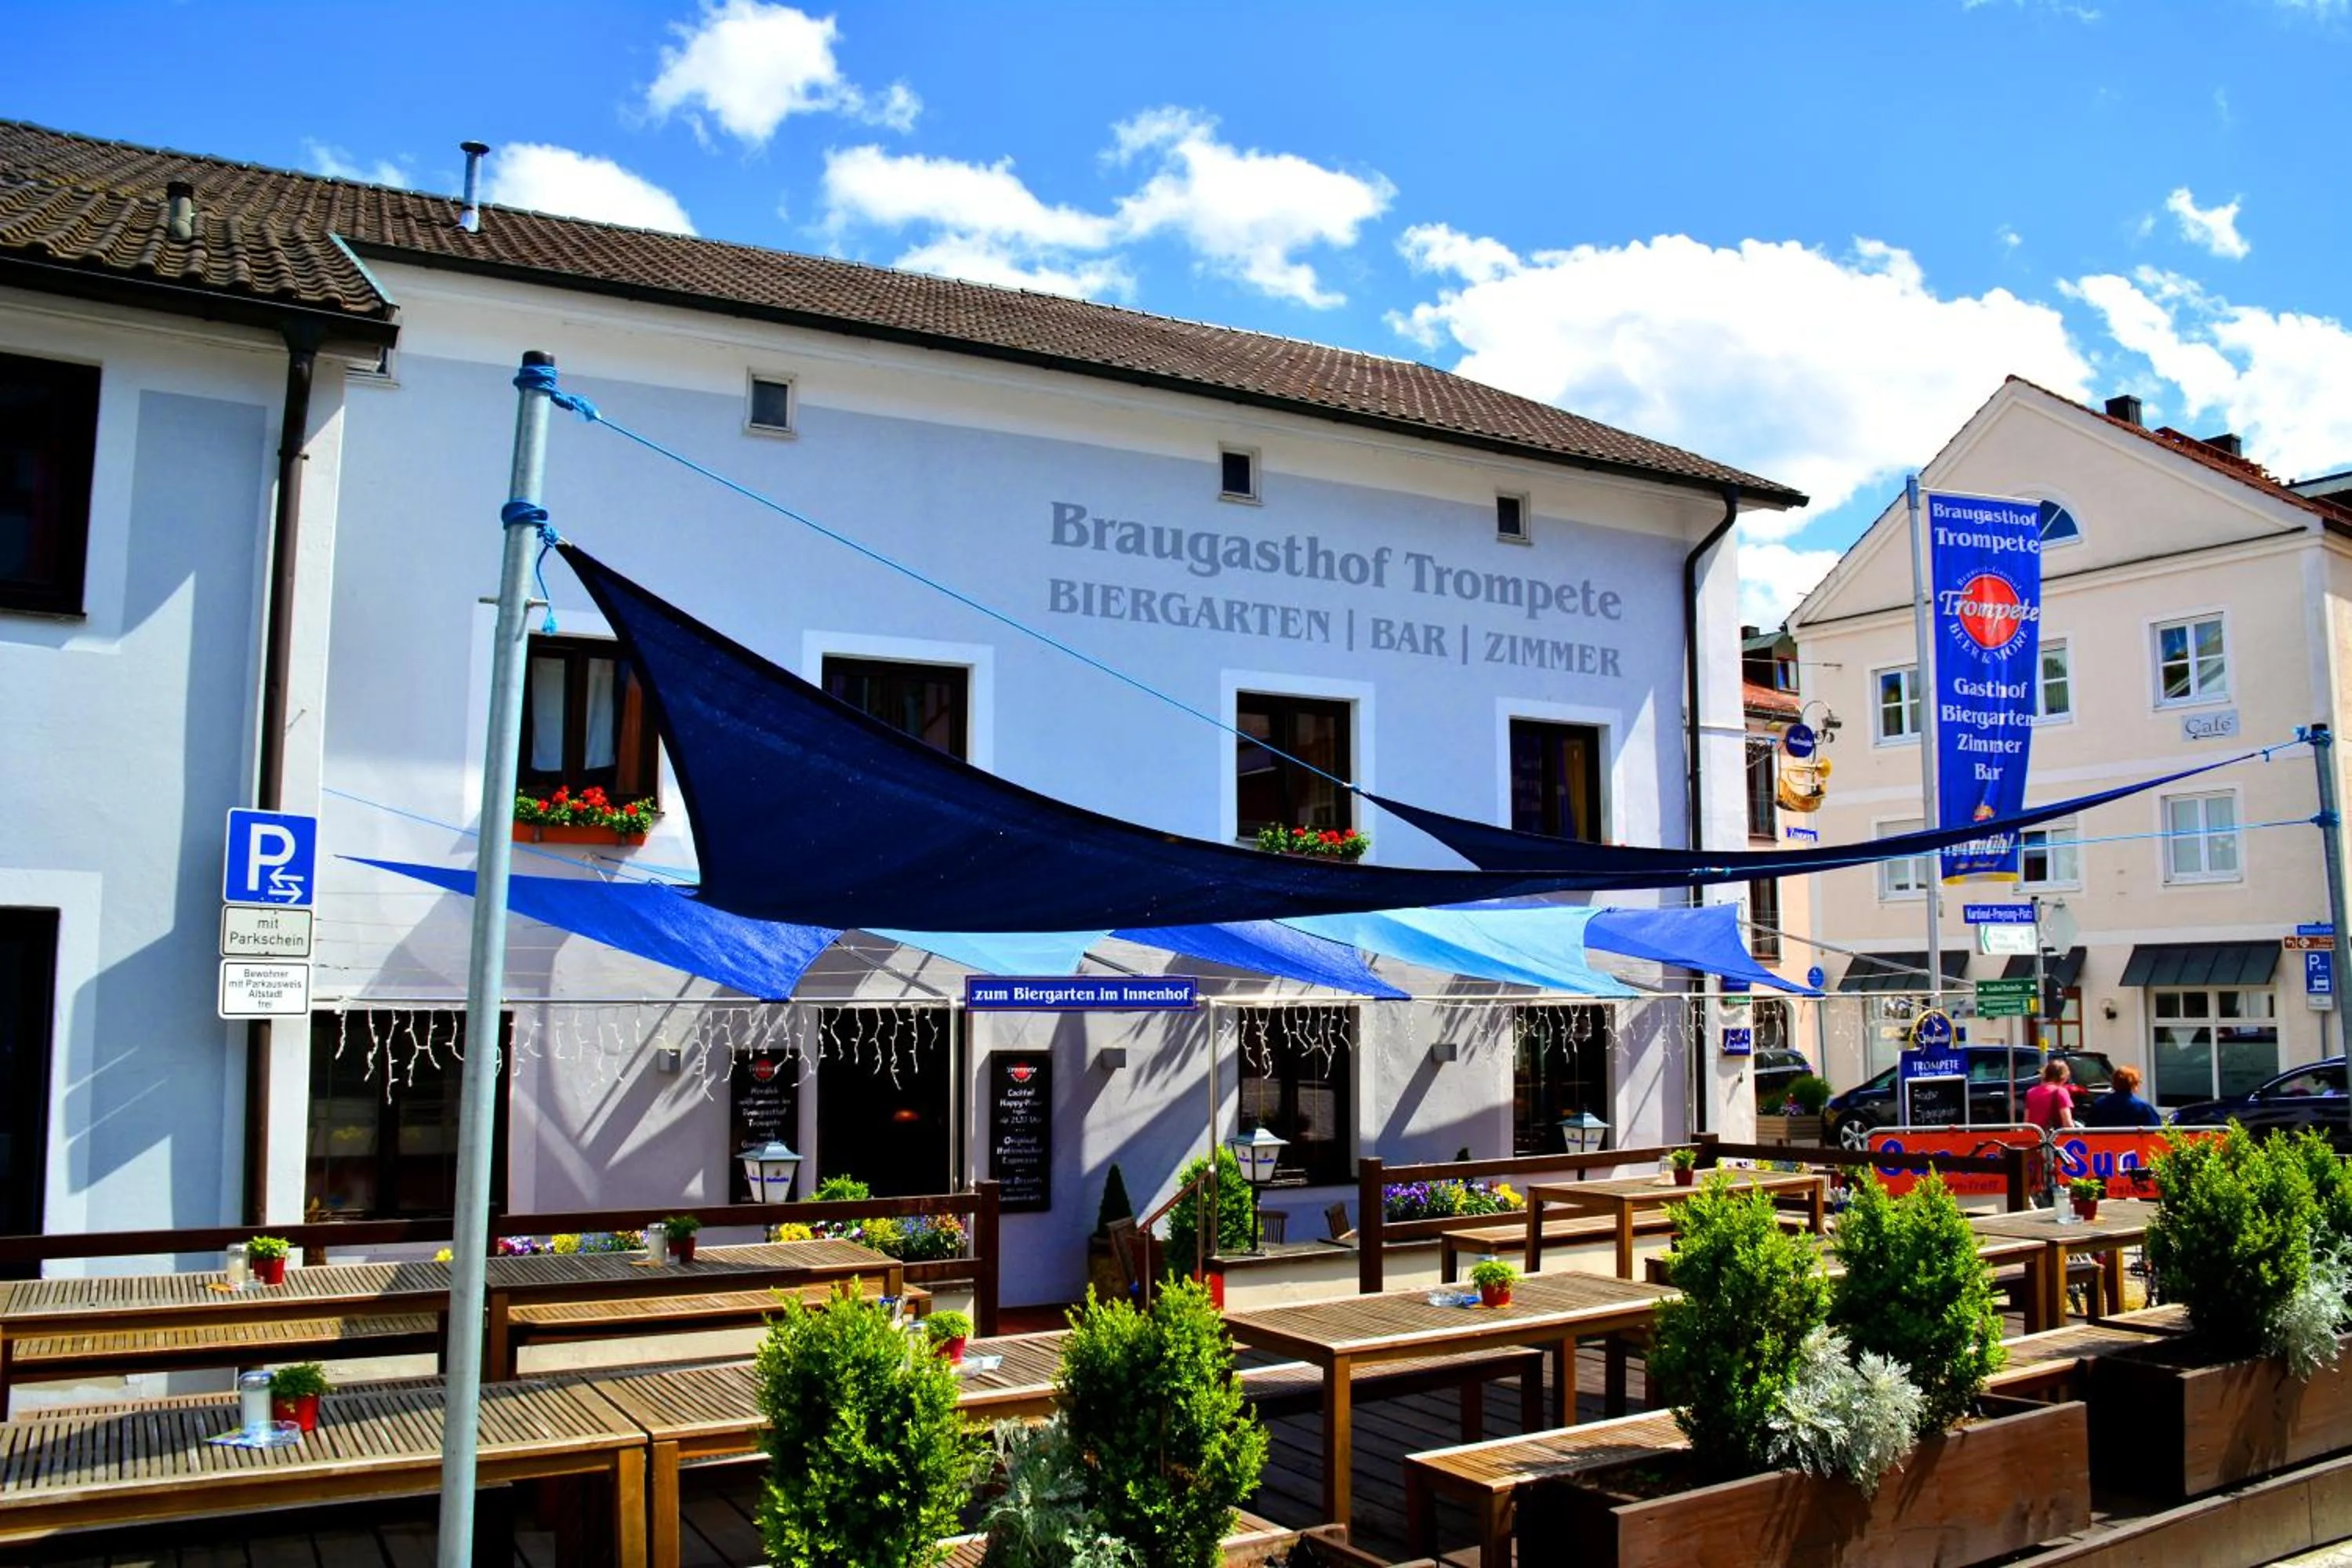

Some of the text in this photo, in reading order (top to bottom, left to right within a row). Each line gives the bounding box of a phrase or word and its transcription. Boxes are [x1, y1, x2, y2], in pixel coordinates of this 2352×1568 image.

[1933, 503, 2038, 526] Braugasthof
[1934, 527, 2040, 554] Trompete
[1050, 501, 1623, 621] Braugasthof Trompete
[1938, 589, 2040, 637] Trompete
[1049, 578, 1331, 643] BIERGARTEN
[1370, 618, 1448, 659] BAR
[1483, 630, 1622, 677] ZIMMER
[1949, 622, 1980, 660] BEER
[1993, 626, 2029, 662] MORE
[1953, 677, 2028, 699] Gasthof
[1941, 705, 2035, 730] Biergarten
[2185, 716, 2233, 735] Café
[1957, 733, 2023, 753] Zimmer
[1974, 763, 2004, 780] Bar
[247, 822, 296, 891] P
[257, 918, 278, 929] mit
[230, 931, 304, 946] Parkschein
[244, 969, 289, 978] Bewohner
[245, 980, 302, 989] Parkausweis
[249, 989, 283, 998] Altstadt
[257, 1000, 272, 1008] frei
[975, 989, 1008, 1000] zum
[1014, 987, 1095, 1004] Biergarten
[1123, 987, 1190, 1001] Innenhof
[1913, 1060, 1960, 1073] TROMPETE
